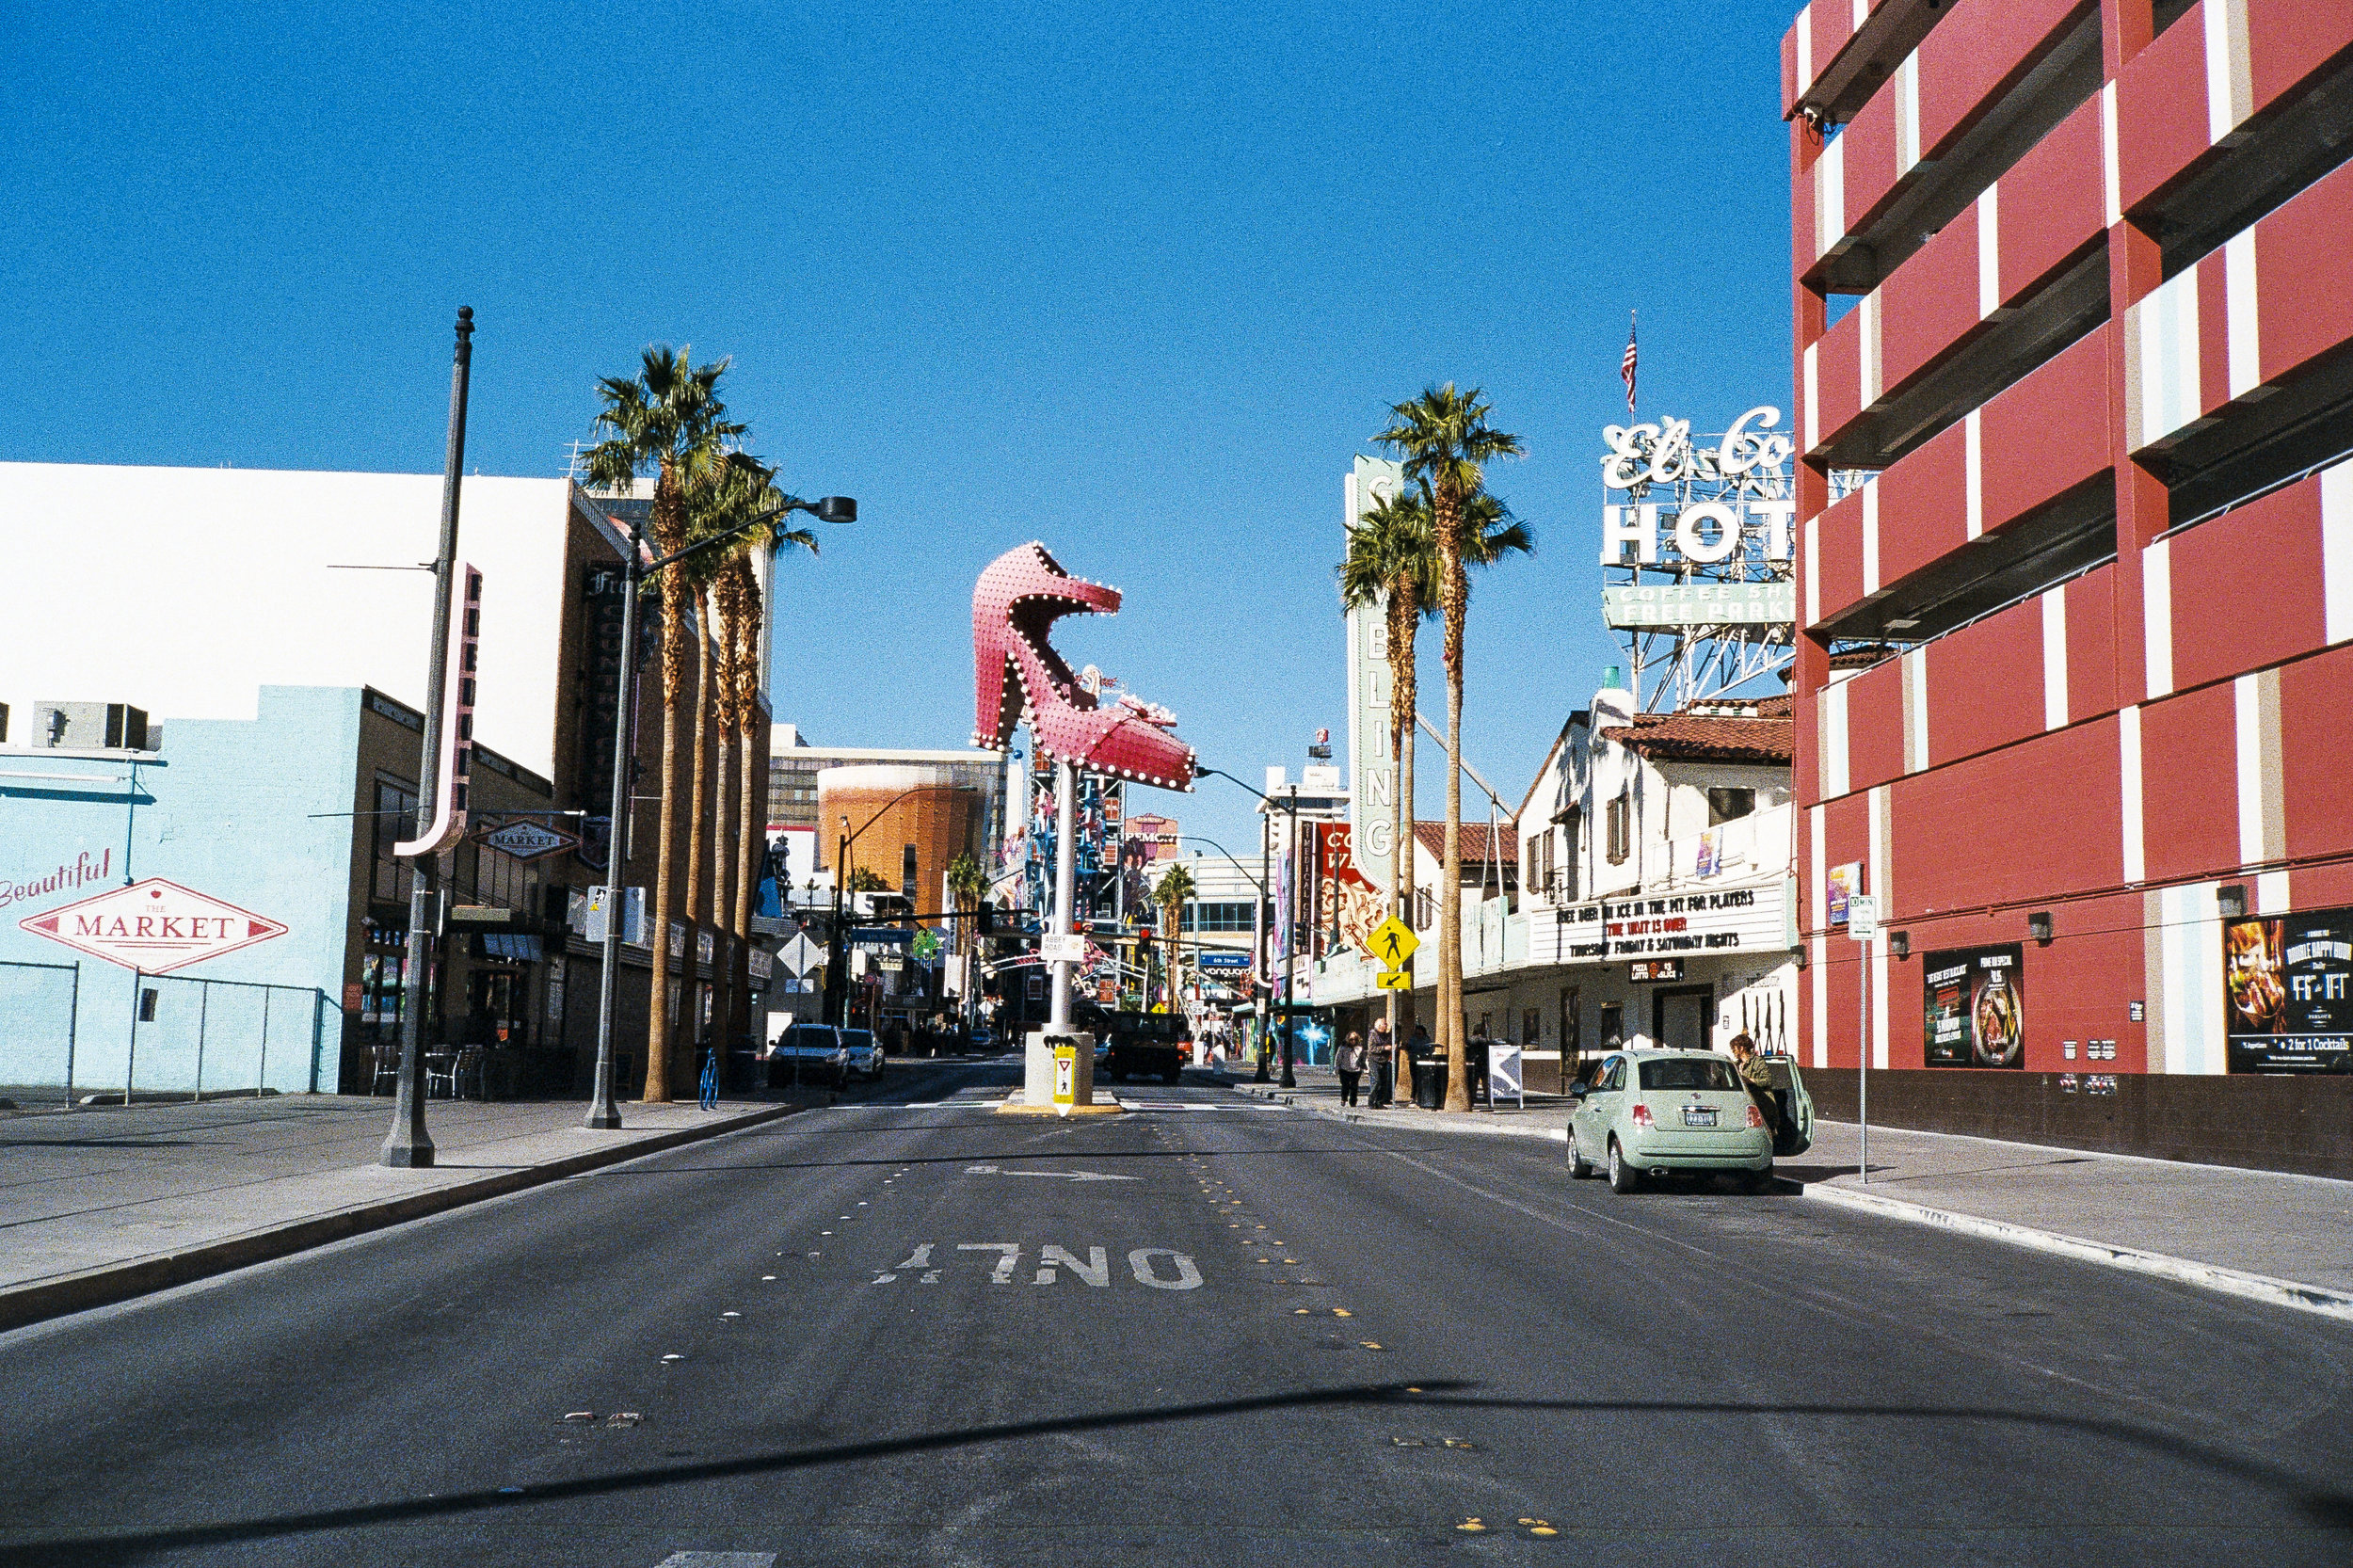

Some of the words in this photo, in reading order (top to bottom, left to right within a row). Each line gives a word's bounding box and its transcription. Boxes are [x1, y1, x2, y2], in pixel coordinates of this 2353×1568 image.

[1604, 419, 1690, 489] El
[1619, 587, 1730, 601] COFFEE
[1624, 603, 1693, 621] FREE
[1365, 475, 1393, 857] GBLING
[494, 835, 555, 845] MARKET
[145, 904, 167, 913] THE
[1709, 890, 1754, 910] PLAYERS
[73, 915, 235, 939] MARKET
[2312, 941, 2333, 958] HAPPY
[1204, 966, 1251, 977] vanguard
[2288, 1038, 2294, 1050] 2
[2295, 1038, 2306, 1050] for
[2313, 1037, 2350, 1050] Cocktails
[871, 1243, 1204, 1290] ONLY
